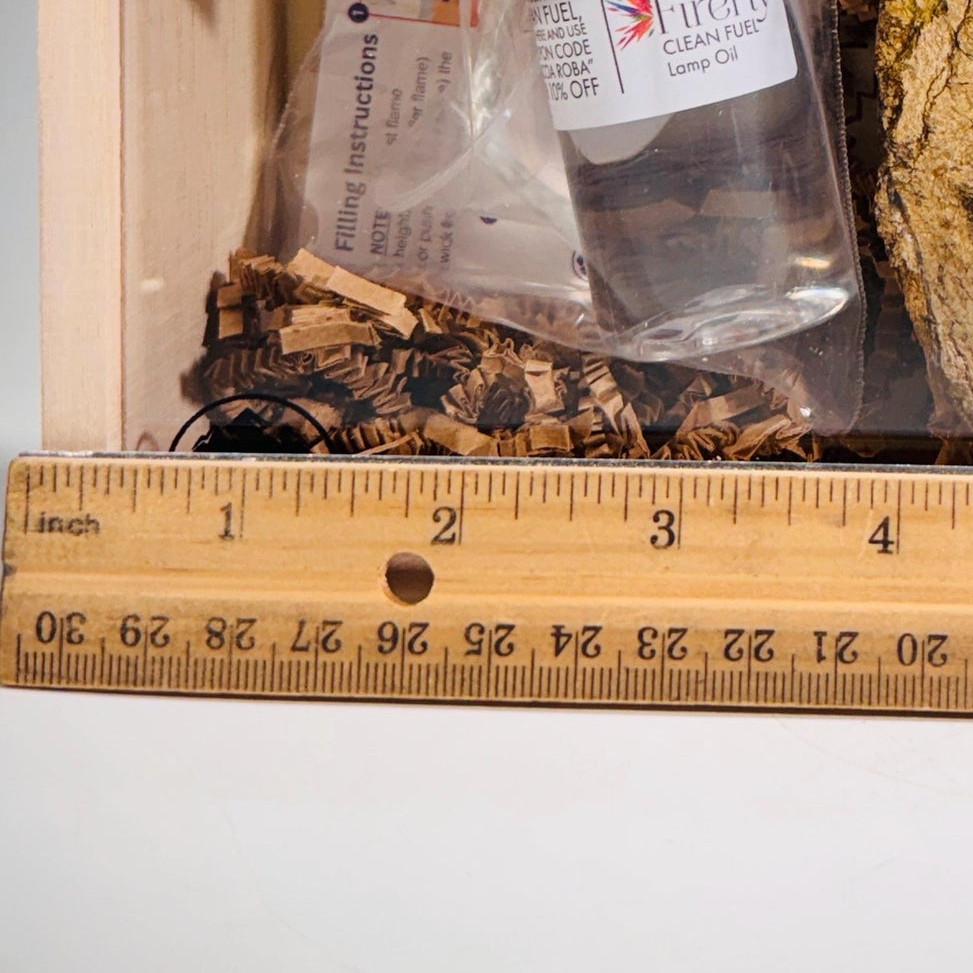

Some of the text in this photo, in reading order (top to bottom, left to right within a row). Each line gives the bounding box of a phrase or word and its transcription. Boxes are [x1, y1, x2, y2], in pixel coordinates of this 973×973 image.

[543, 1, 582, 25] FUEL,
[548, 28, 565, 40] AND
[568, 23, 587, 37] USE
[663, 18, 759, 55] CLEAN FUEL
[555, 39, 592, 59] CODE
[667, 45, 739, 77] Lamp Oil
[556, 59, 593, 78] ROBA"
[570, 78, 599, 99] OFF
[334, 33, 379, 252] Filling Instructions
[37, 511, 100, 536] inch
[219, 502, 235, 541] 1
[430, 505, 458, 546] 2
[649, 509, 676, 550] 3
[867, 516, 895, 554] 4
